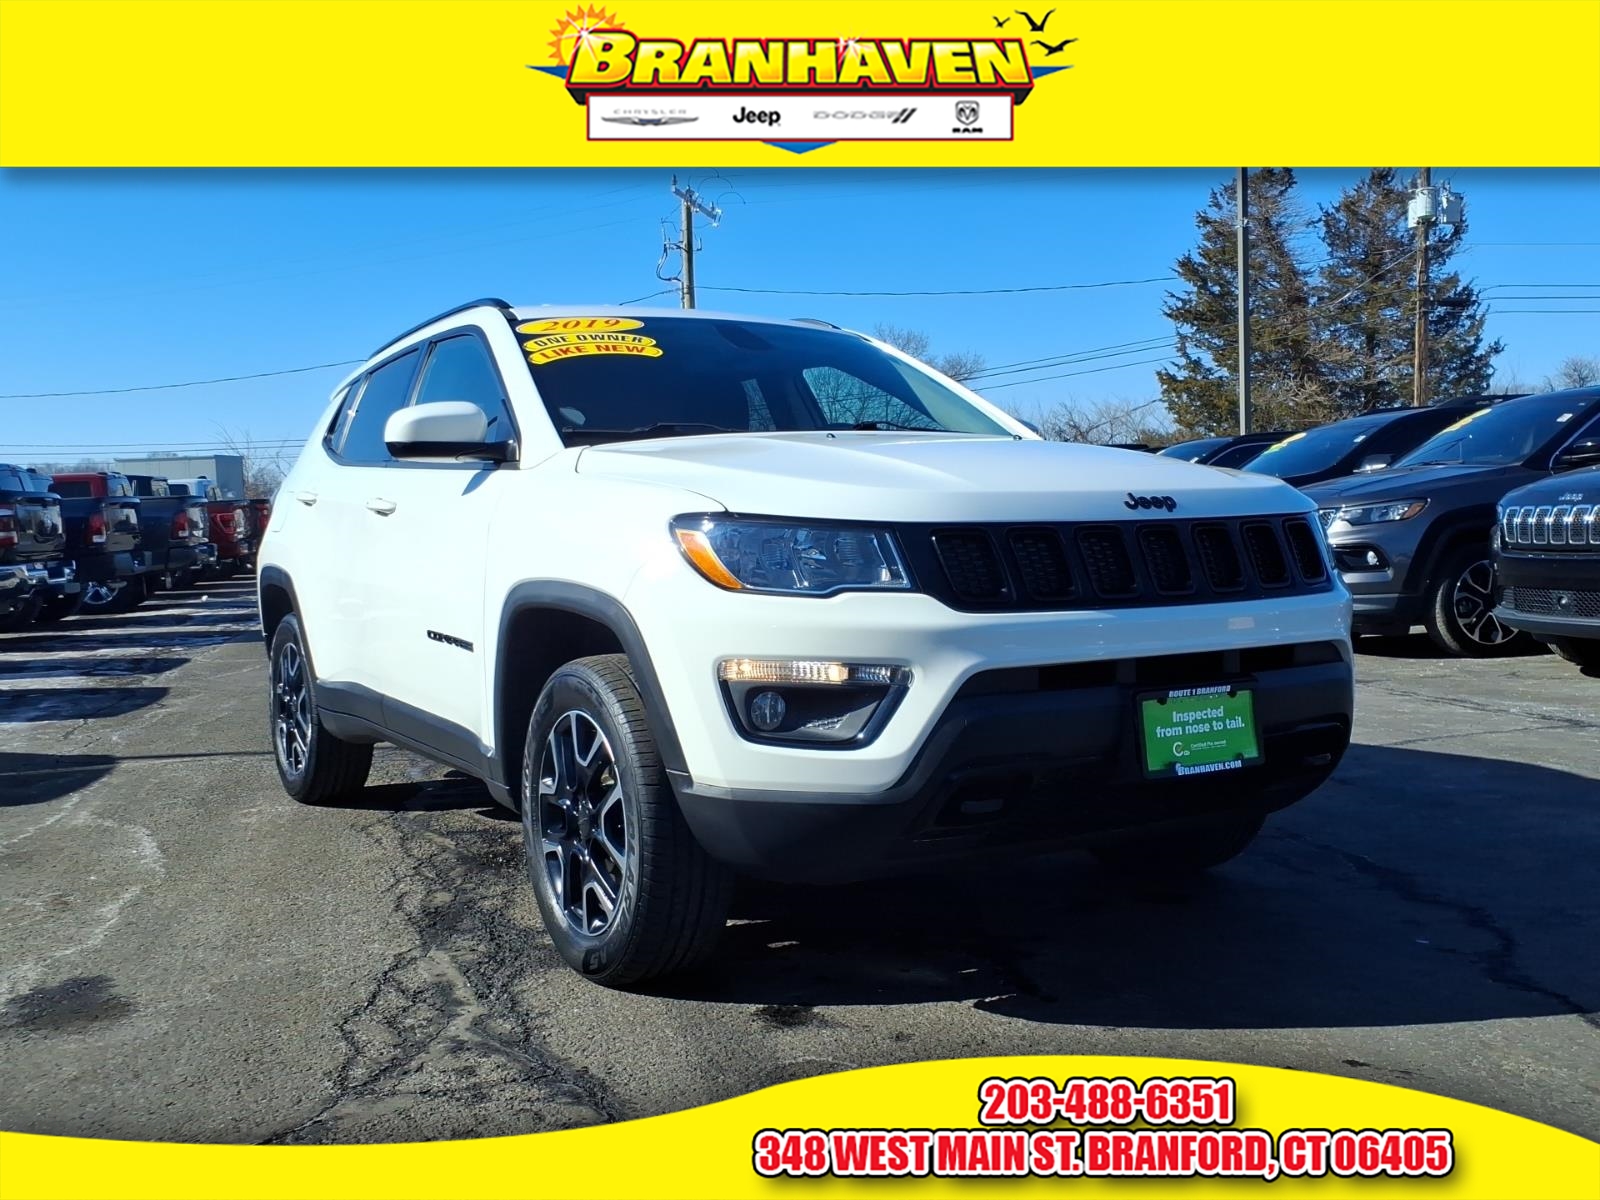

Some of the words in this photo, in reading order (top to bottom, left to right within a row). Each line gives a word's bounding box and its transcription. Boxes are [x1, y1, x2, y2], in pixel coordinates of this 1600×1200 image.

[542, 318, 621, 331] 2019
[533, 336, 569, 347] ONE
[576, 334, 643, 343] OWNER
[540, 346, 585, 359] LIKE
[595, 344, 645, 354] NEW
[1123, 492, 1177, 513] Jeep
[1168, 688, 1192, 698] ROUTE
[1172, 706, 1224, 723] Inspected
[1156, 726, 1182, 738] from
[1185, 723, 1211, 735] nose
[1212, 720, 1224, 731] to
[1225, 716, 1245, 729] tail.
